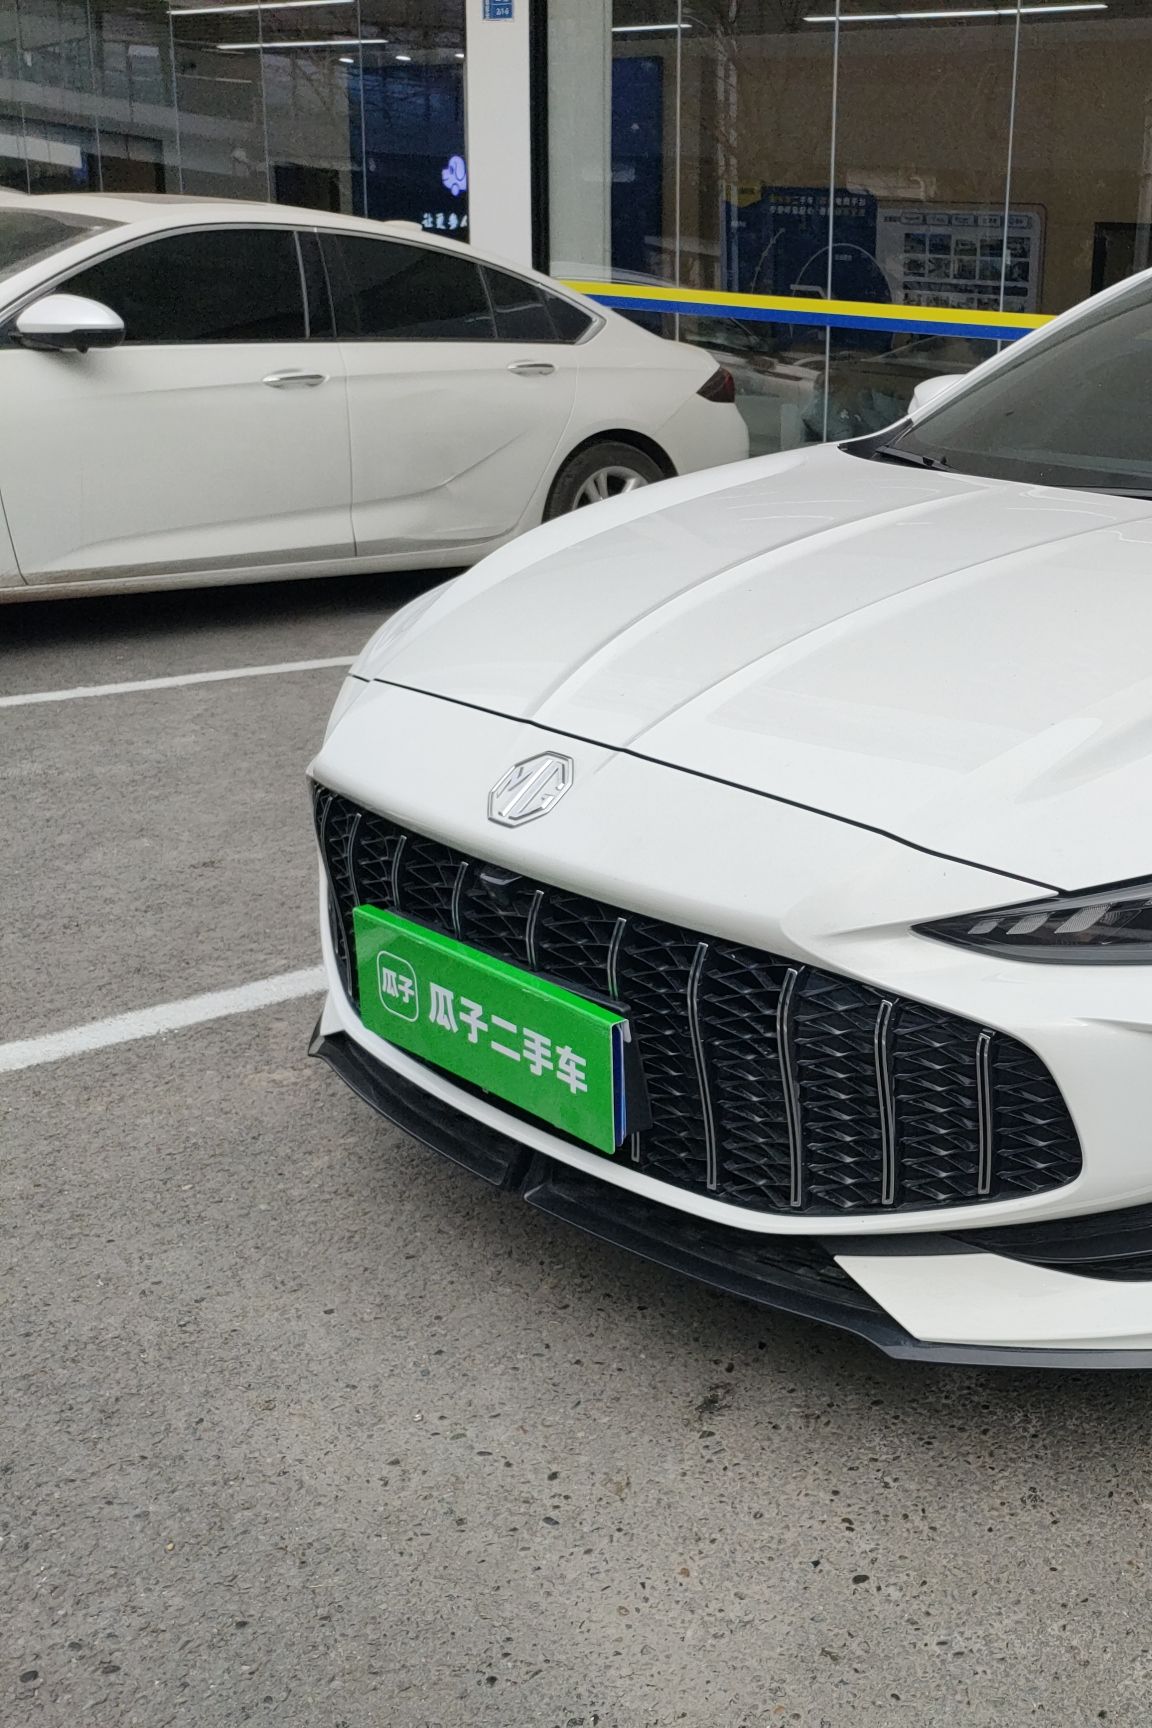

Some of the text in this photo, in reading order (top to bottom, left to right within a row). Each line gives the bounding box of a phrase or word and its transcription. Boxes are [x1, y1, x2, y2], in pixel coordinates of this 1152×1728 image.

[492, 755, 569, 824] MG
[382, 967, 588, 1094] 瓜子 瓜子二手车
